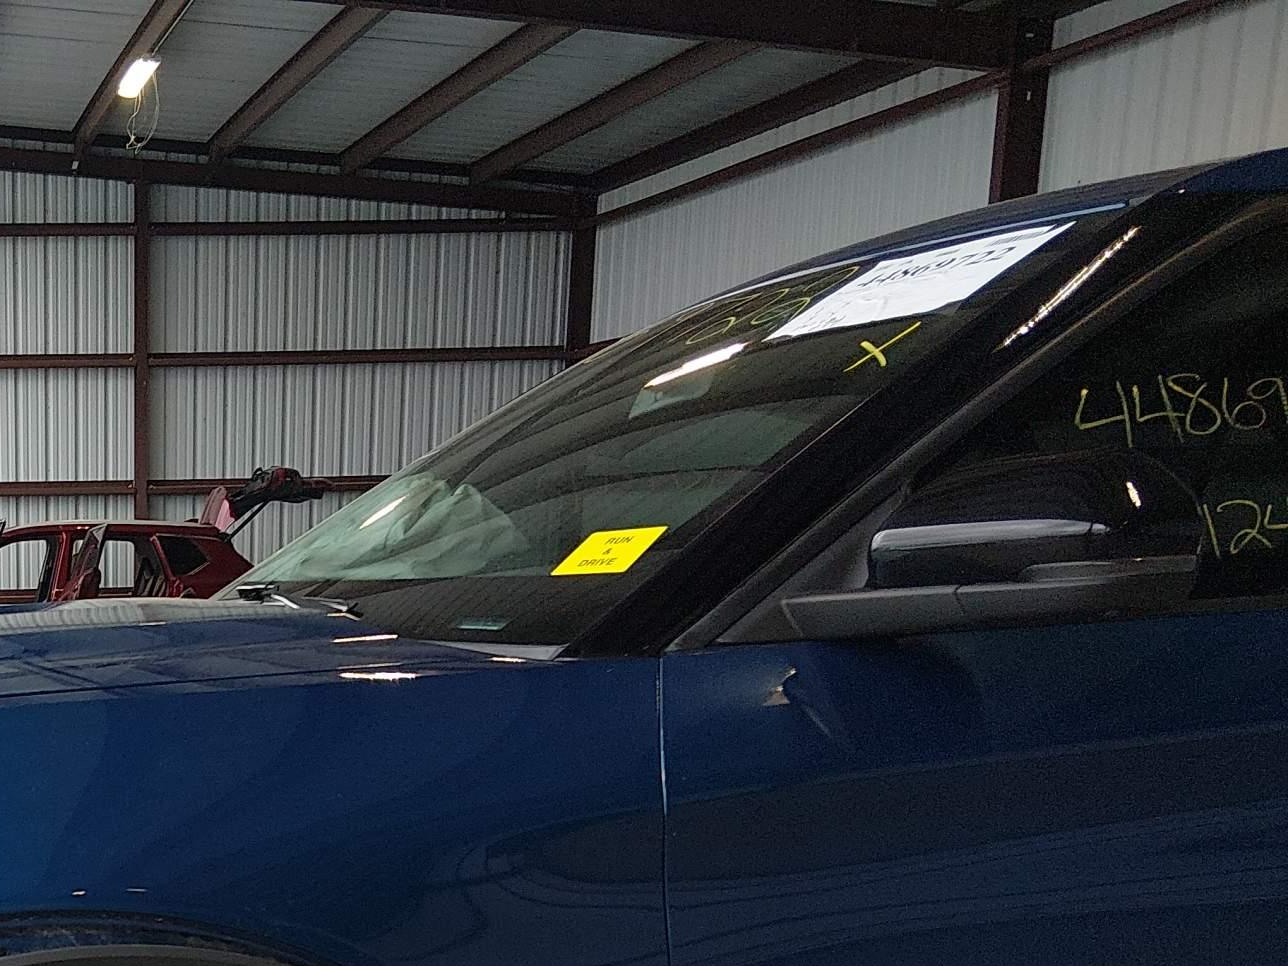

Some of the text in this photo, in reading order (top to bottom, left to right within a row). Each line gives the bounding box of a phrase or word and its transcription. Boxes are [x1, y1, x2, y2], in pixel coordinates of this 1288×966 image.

[858, 246, 1016, 288] 44869722
[605, 536, 633, 545] RUN
[577, 558, 618, 567] DRIVE
